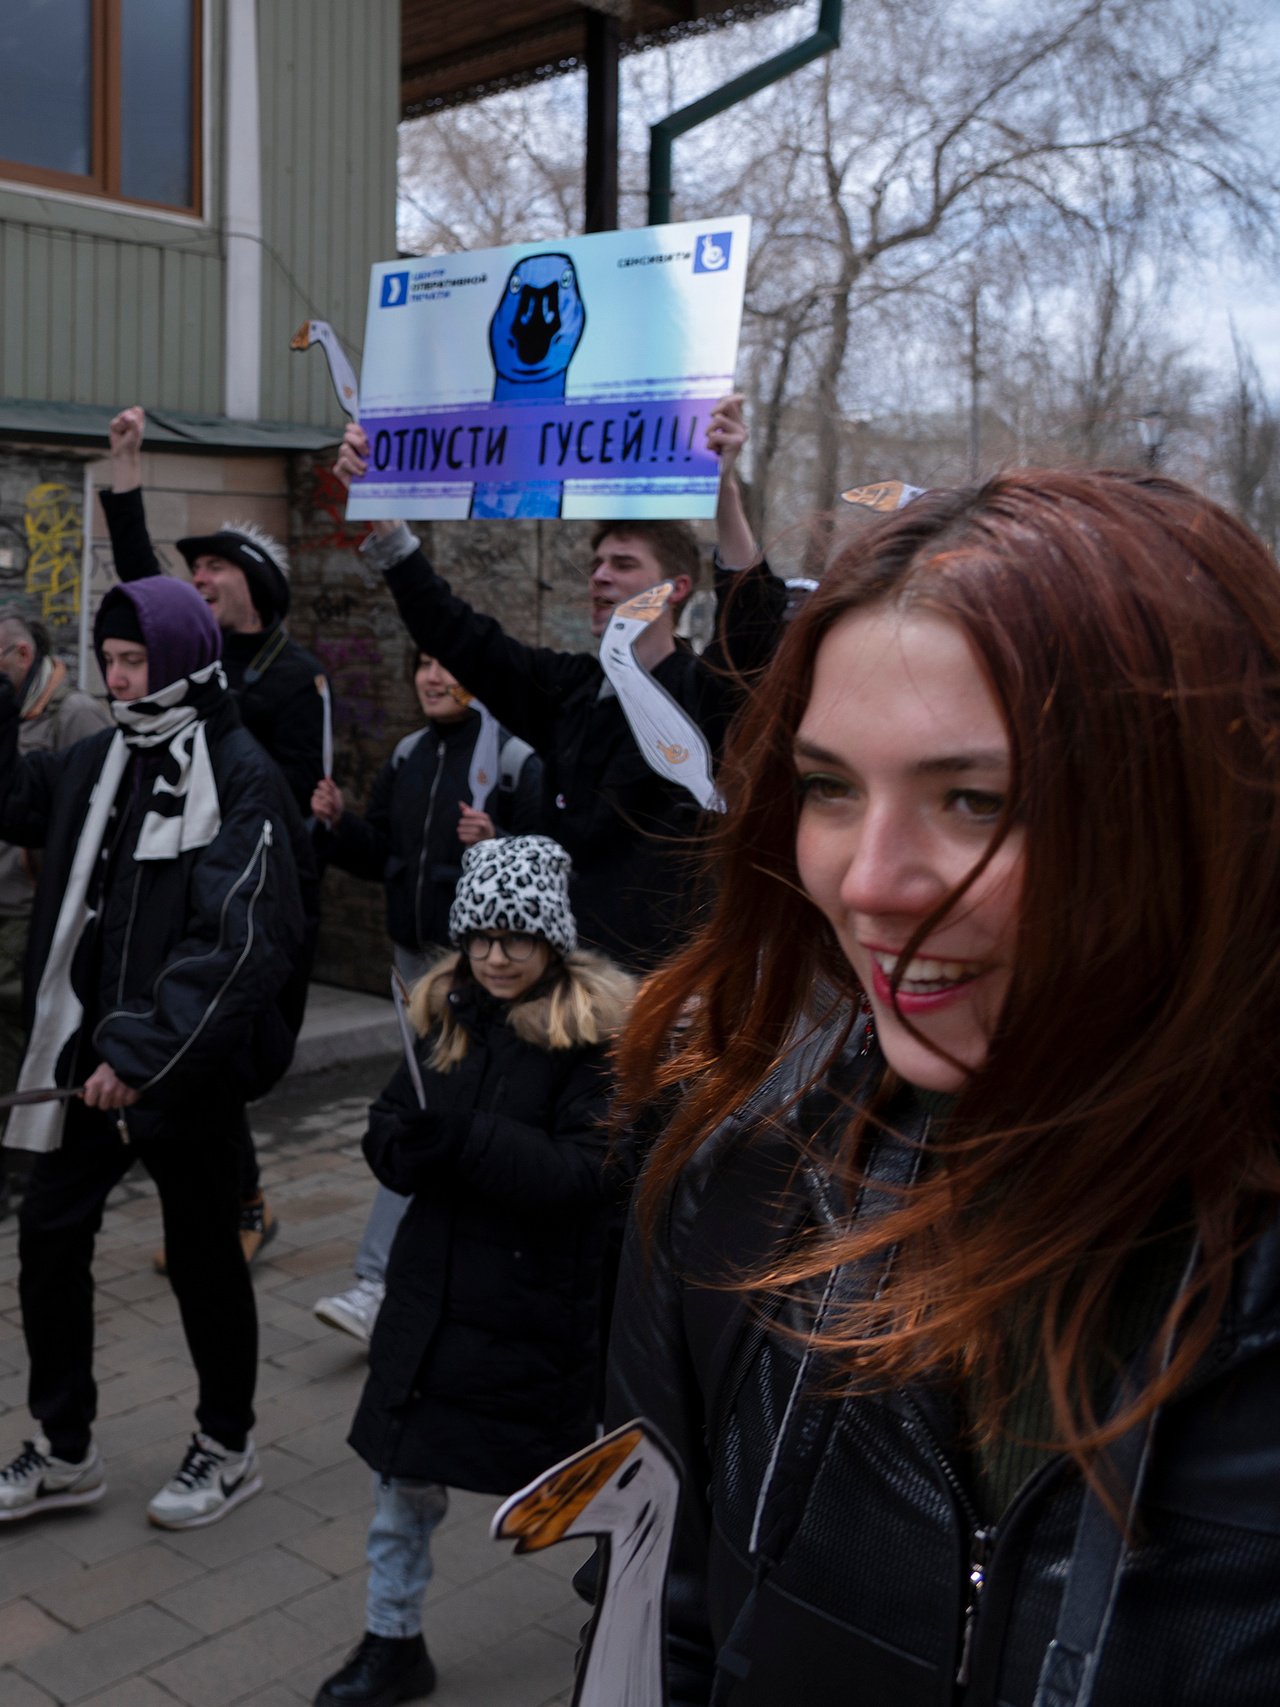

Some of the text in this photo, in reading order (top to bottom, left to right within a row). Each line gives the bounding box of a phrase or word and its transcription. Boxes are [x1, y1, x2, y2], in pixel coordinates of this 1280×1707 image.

[411, 274, 487, 291] ОПЕРАТИВНОЙ
[373, 409, 698, 471] ОТПУСТИ ГУСЕЙ!!!
